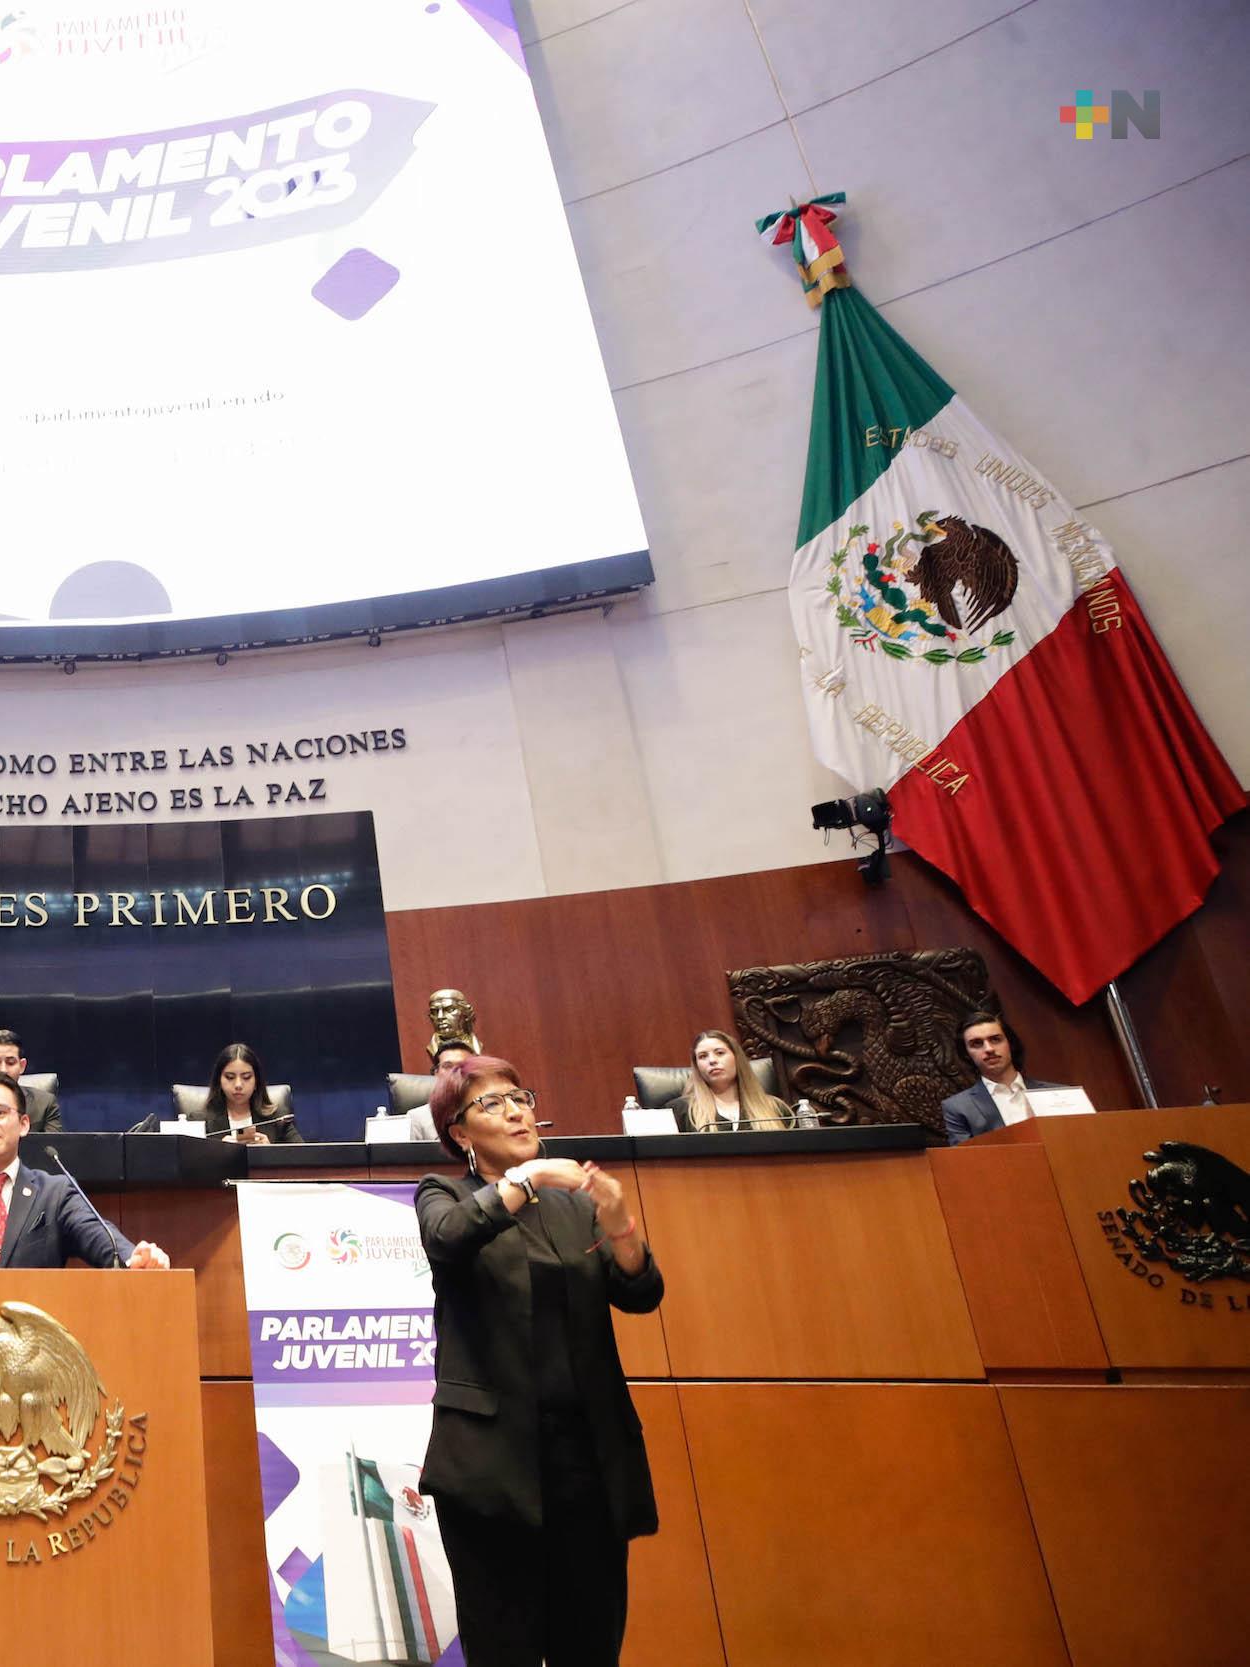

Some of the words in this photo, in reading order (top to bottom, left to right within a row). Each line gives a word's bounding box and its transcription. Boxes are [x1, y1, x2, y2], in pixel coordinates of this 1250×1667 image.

[204, 151, 357, 228] 2023
[974, 451, 1056, 511] UNIDOS
[69, 749, 168, 774] ENTRE
[179, 745, 234, 769] LAS
[247, 728, 407, 765] NACIONES
[61, 791, 158, 816] AJENO
[170, 788, 203, 811] ES
[214, 785, 254, 807] LA
[266, 778, 327, 804] PAZ
[73, 883, 338, 928] PRIMERO
[364, 1246, 429, 1261] JUVENIL
[1097, 1211, 1164, 1288] SENADO
[1181, 1288, 1214, 1310] DE
[1227, 1295, 1250, 1312] L
[260, 1314, 436, 1342] PARLAMEN
[272, 1343, 406, 1371] JUVENIL
[6, 1539, 42, 1564] LA
[47, 1411, 149, 1557] REPUBLICA
